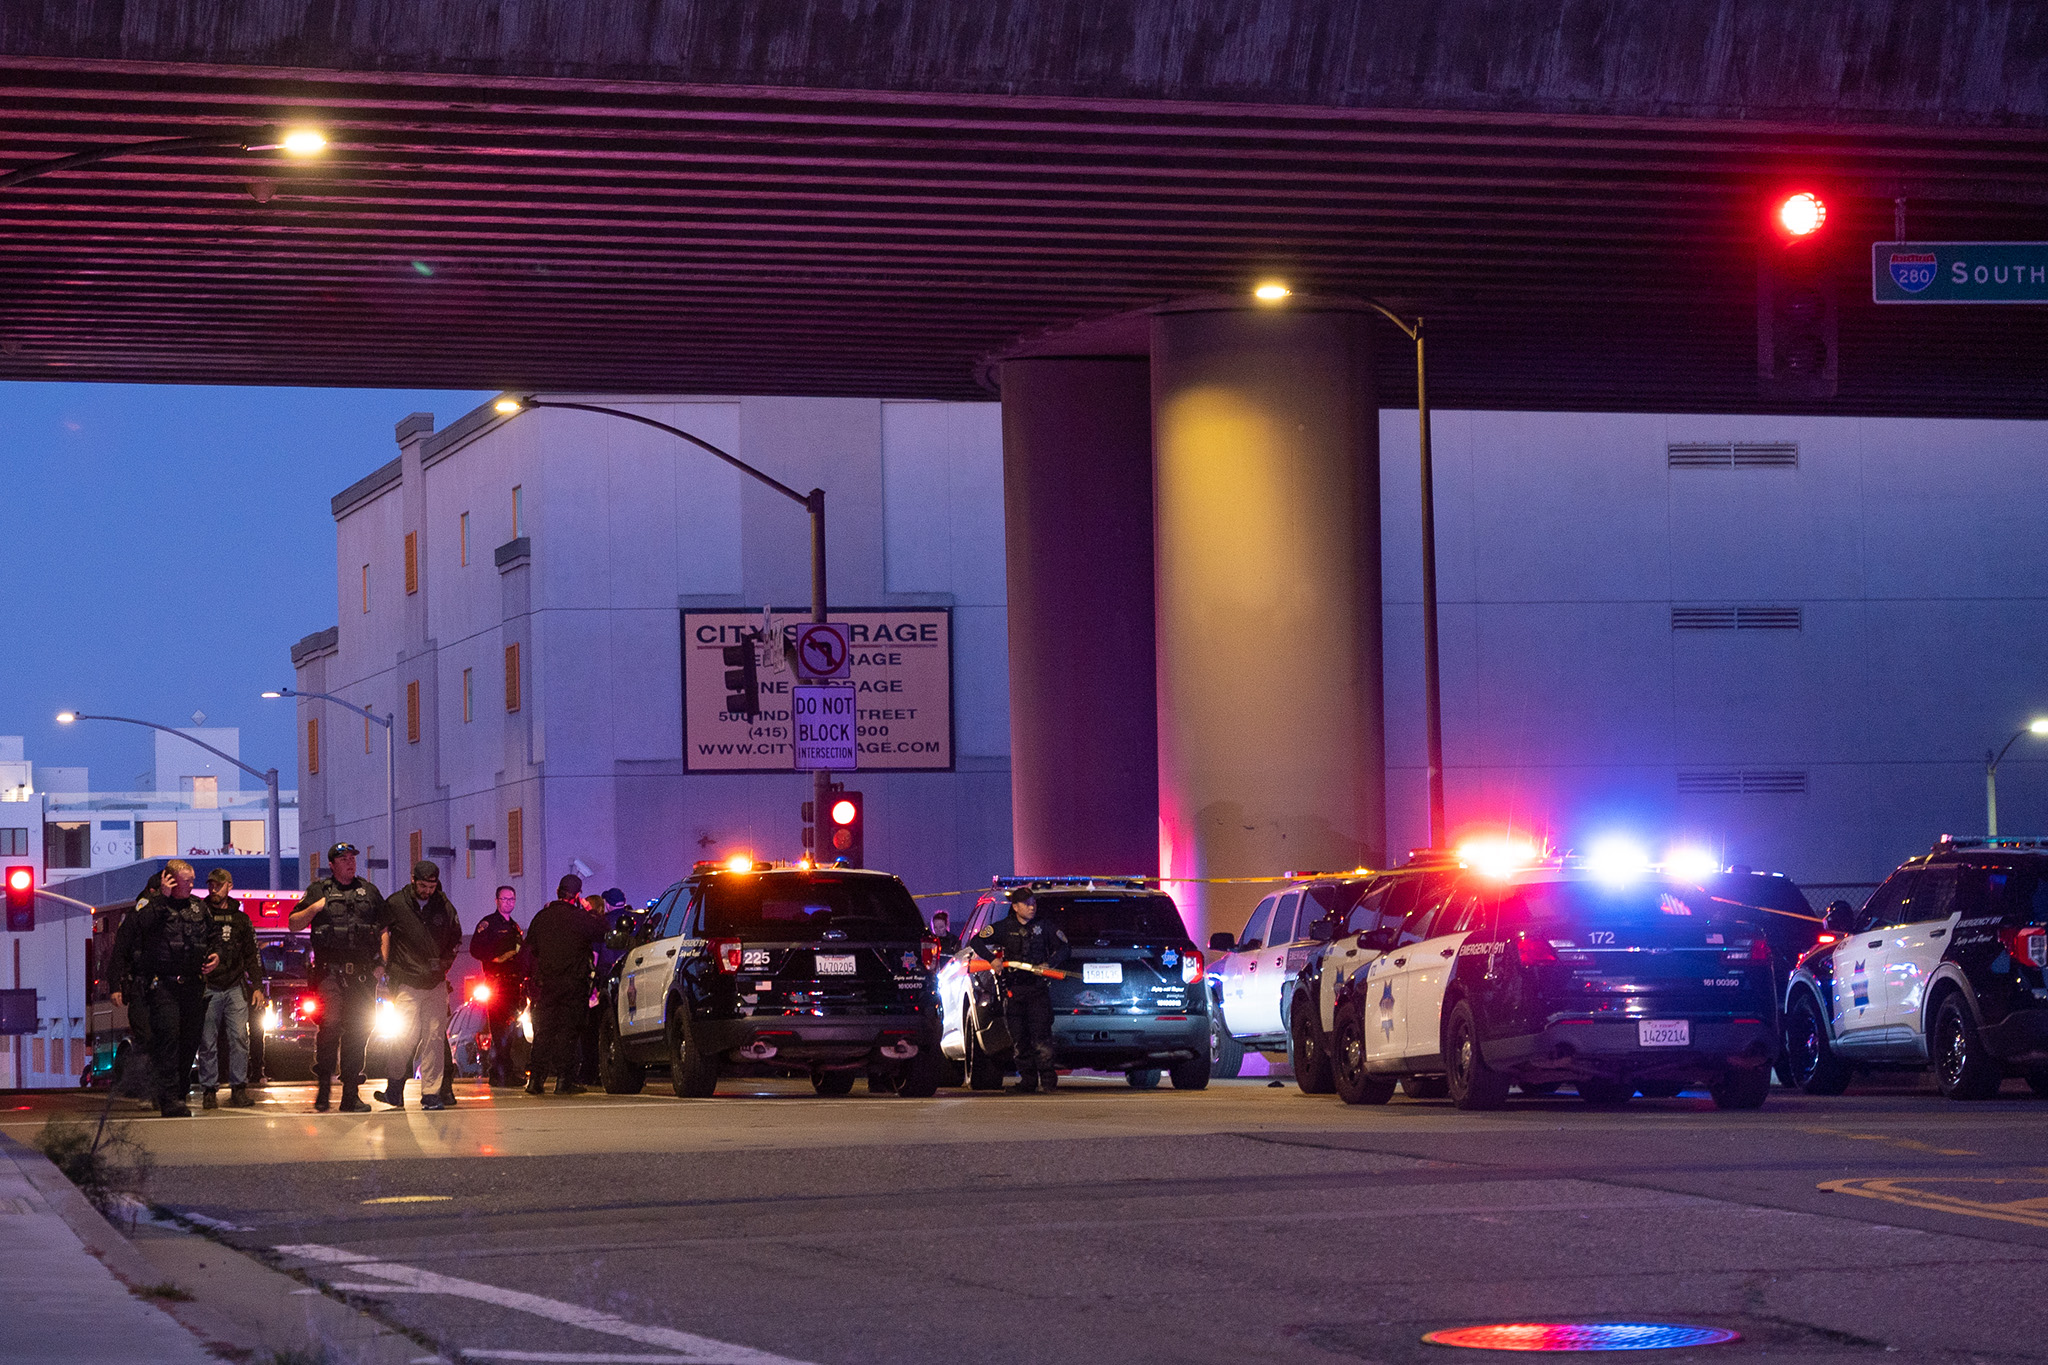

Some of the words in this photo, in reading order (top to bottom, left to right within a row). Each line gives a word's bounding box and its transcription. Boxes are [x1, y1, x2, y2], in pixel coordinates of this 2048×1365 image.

[1899, 269, 1930, 284] 280
[1951, 261, 2045, 284] SOUTH
[783, 624, 938, 643] SRAGE
[796, 697, 816, 714] DO
[823, 697, 853, 714] NOT
[857, 709, 917, 719] TREET
[749, 727, 787, 740] (415)
[799, 724, 849, 741] BLOCK
[798, 747, 853, 759] INTERSECTION
[1588, 932, 1615, 944] 172
[1459, 943, 1493, 956] EMERGENCY
[1493, 942, 1505, 954] 911
[744, 951, 770, 964] 225
[819, 962, 854, 972] 1470205
[1643, 1030, 1686, 1042] 1429214
